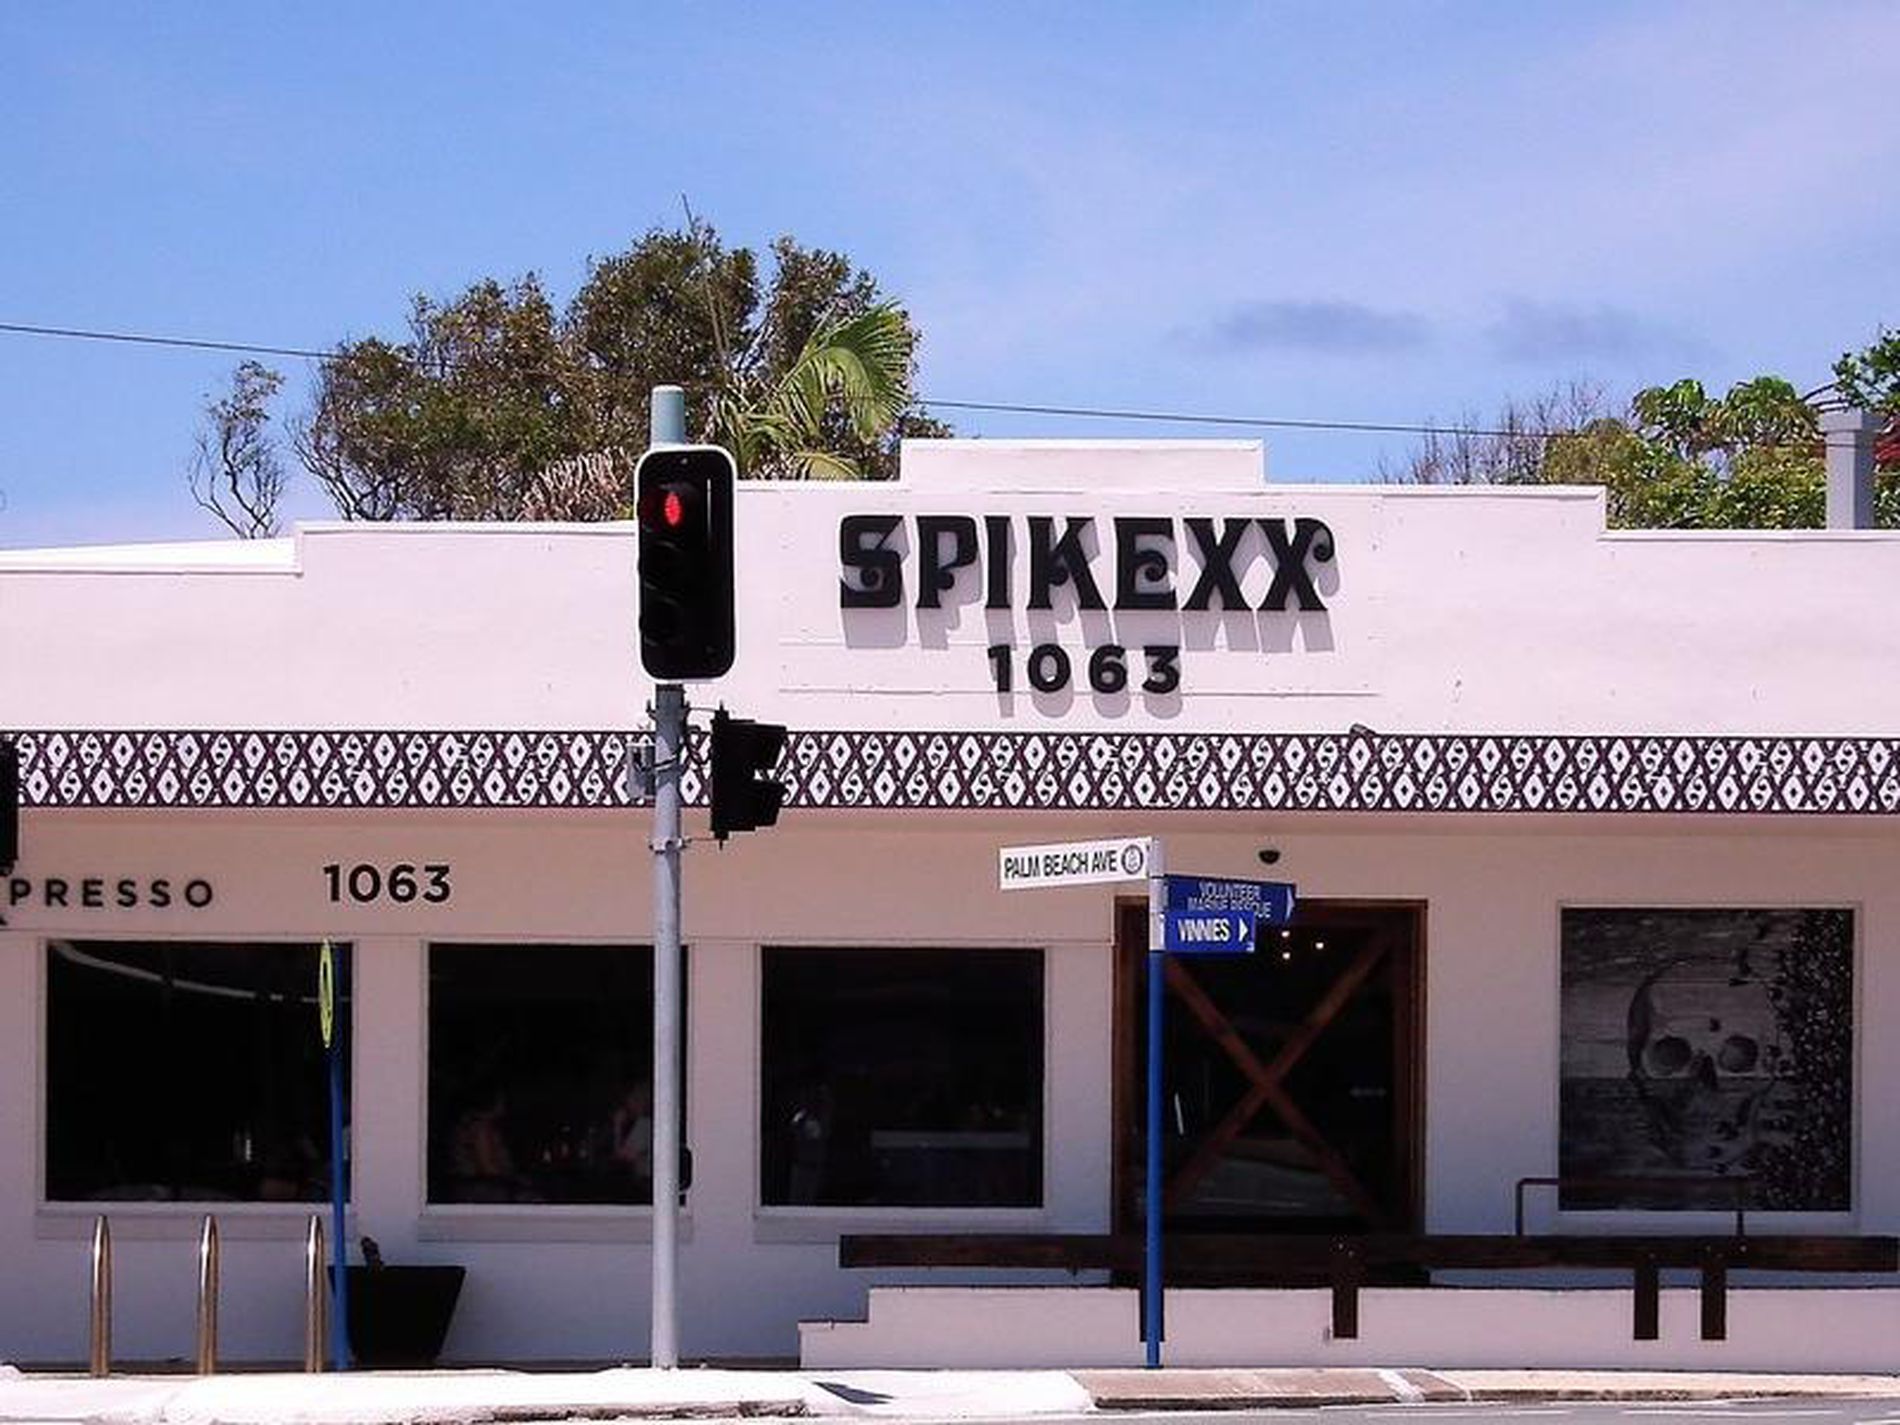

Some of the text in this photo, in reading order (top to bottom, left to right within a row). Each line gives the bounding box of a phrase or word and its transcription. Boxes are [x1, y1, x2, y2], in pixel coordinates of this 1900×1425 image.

[840, 515, 1336, 611] SPIKEXX
[987, 645, 1180, 693] 1063
[1004, 850, 1118, 878] PALM BEACH AVE
[9, 864, 451, 908] PRESSO 1063
[1199, 881, 1260, 901] VOLUNTEER
[1177, 918, 1231, 942] VINNIES
